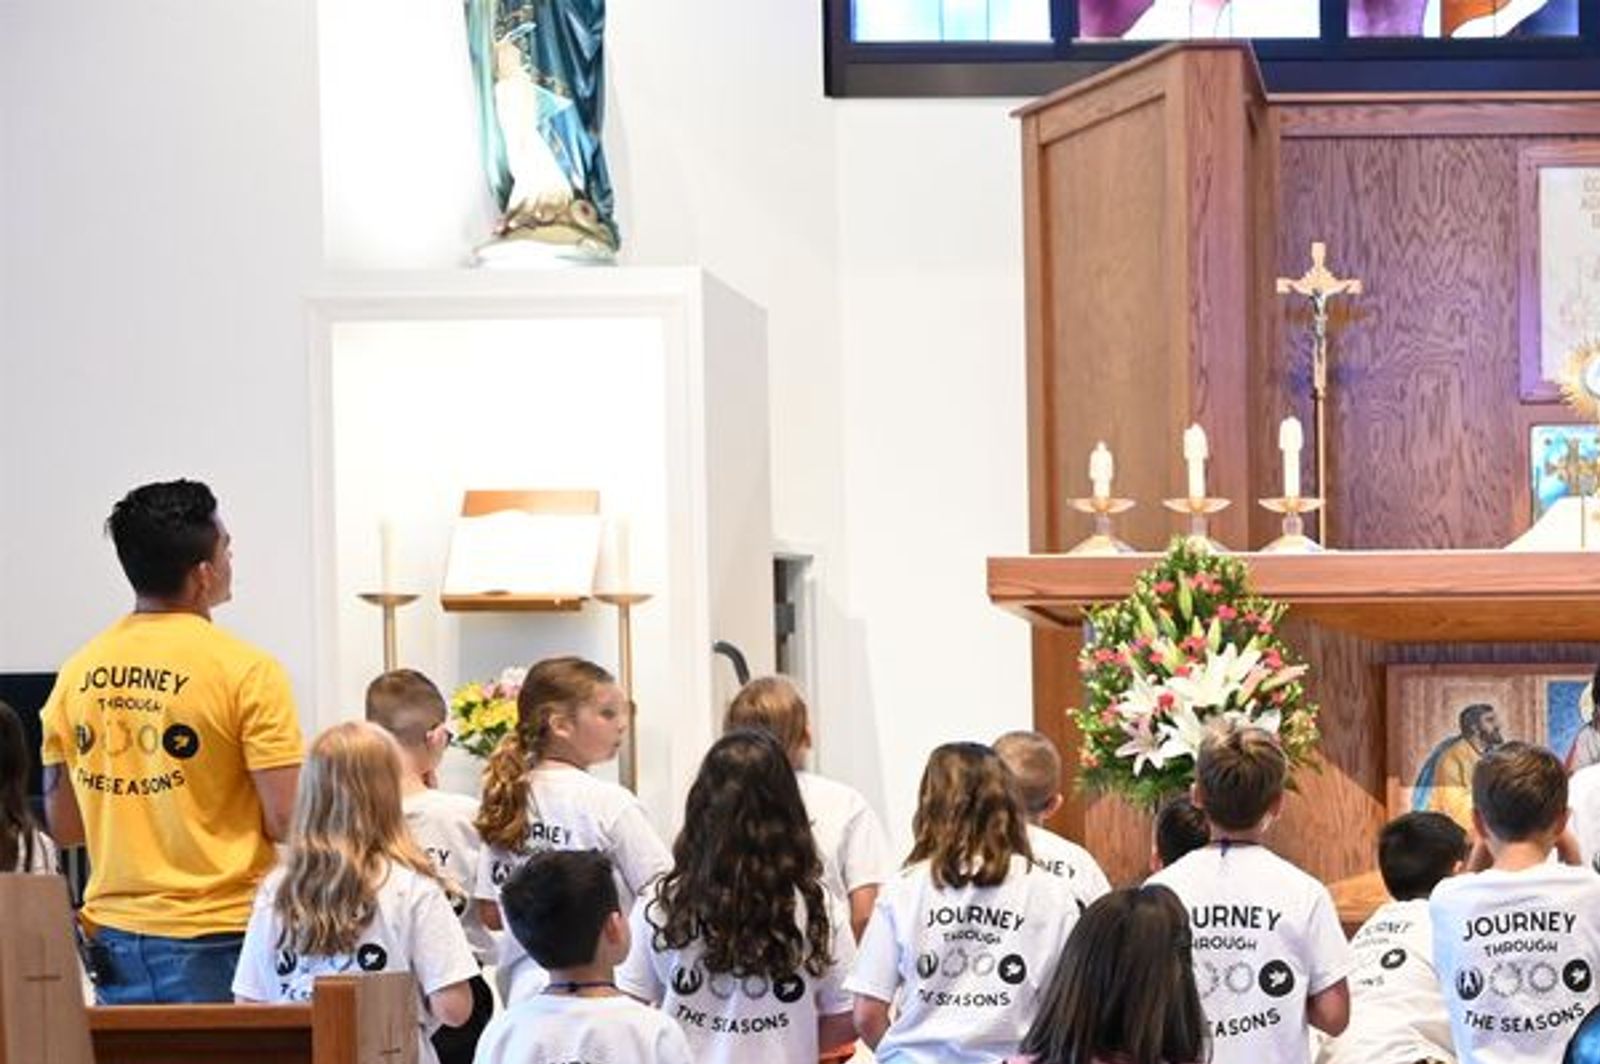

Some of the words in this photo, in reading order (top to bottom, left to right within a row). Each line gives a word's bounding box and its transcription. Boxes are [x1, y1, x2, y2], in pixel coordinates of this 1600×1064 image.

[80, 666, 190, 695] JOURNEY
[927, 906, 1024, 931] JOURNEY
[1192, 905, 1281, 931] URNEY
[1463, 911, 1577, 941] JOURNEY
[1193, 936, 1257, 951] HROUGH
[1484, 939, 1559, 957] THROUGH
[677, 1004, 704, 1027] THE
[1208, 1007, 1281, 1038] ASONS
[1464, 1010, 1495, 1030] THE
[1500, 1002, 1585, 1033] SEASONS
